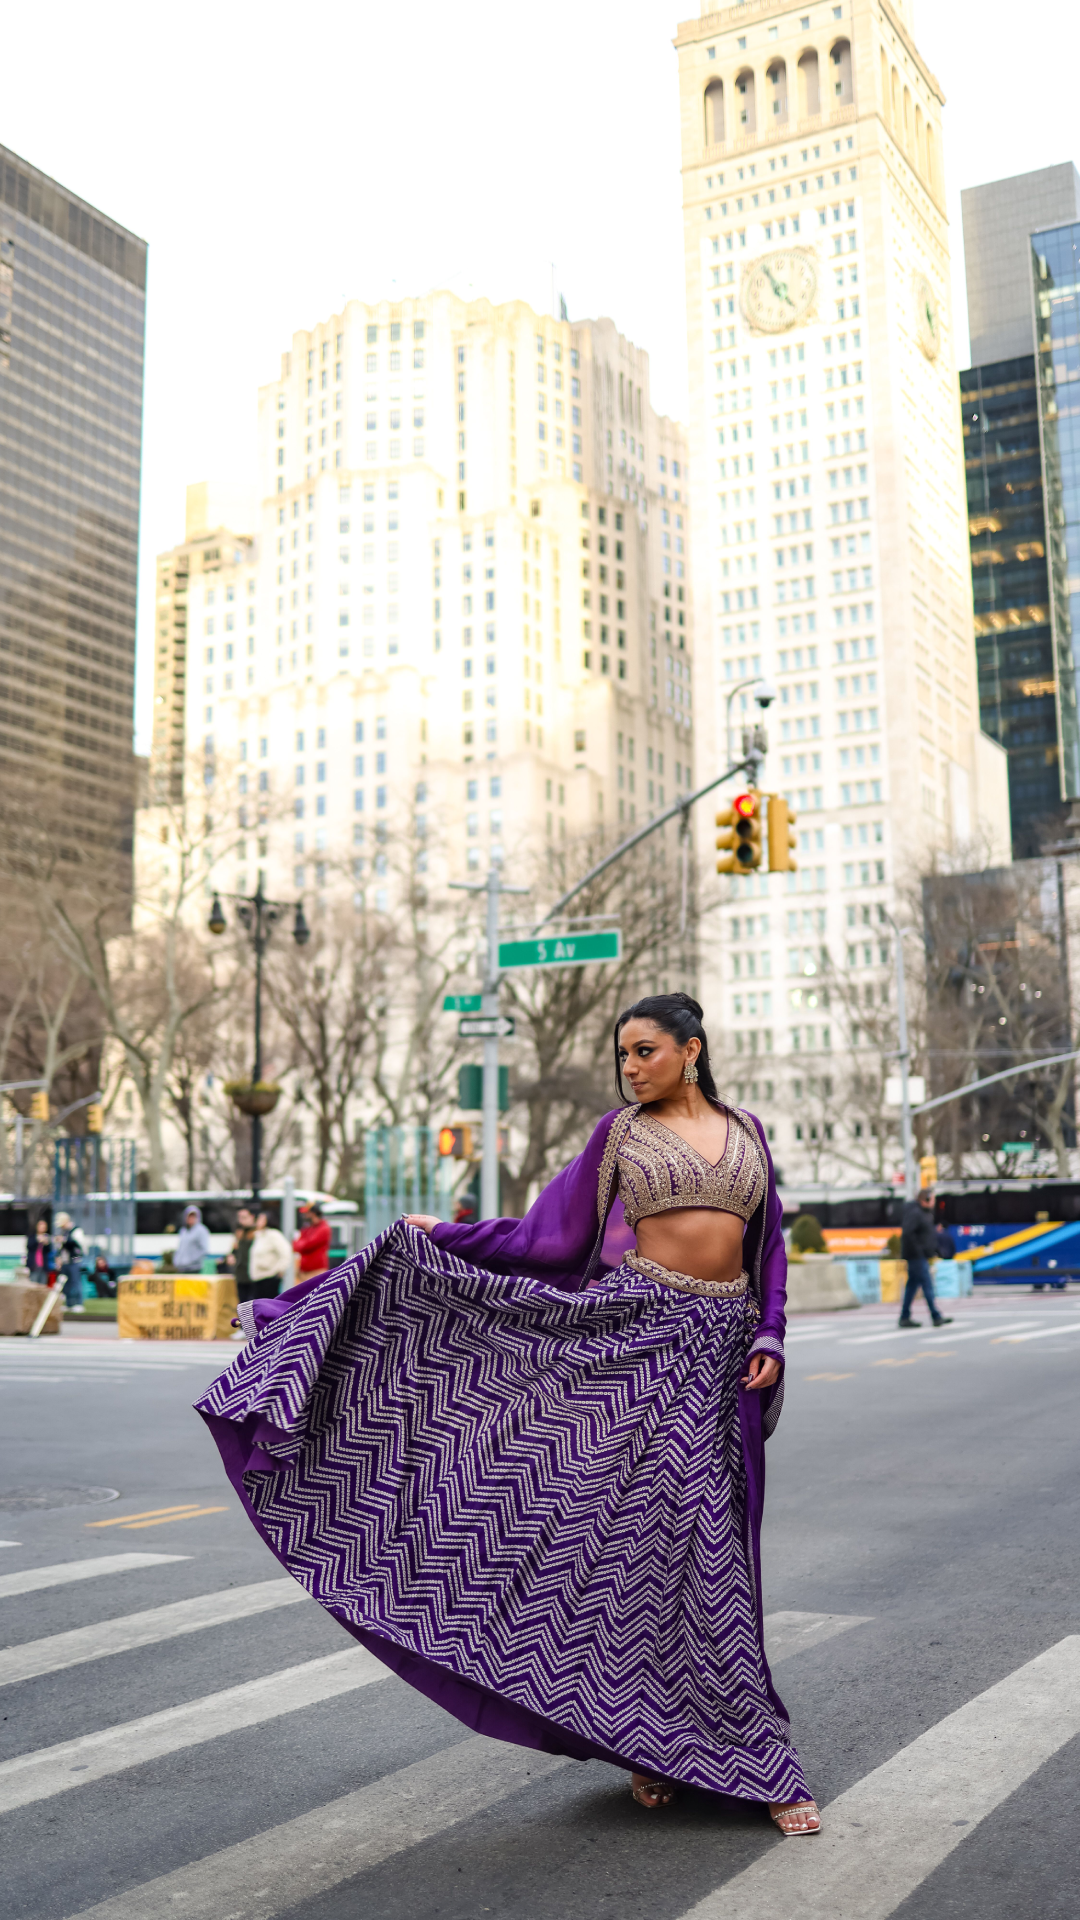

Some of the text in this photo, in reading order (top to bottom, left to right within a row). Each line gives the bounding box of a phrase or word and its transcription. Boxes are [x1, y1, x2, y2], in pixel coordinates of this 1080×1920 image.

[537, 941, 576, 961] 5 Av
[162, 1301, 208, 1319] SEAT IN
